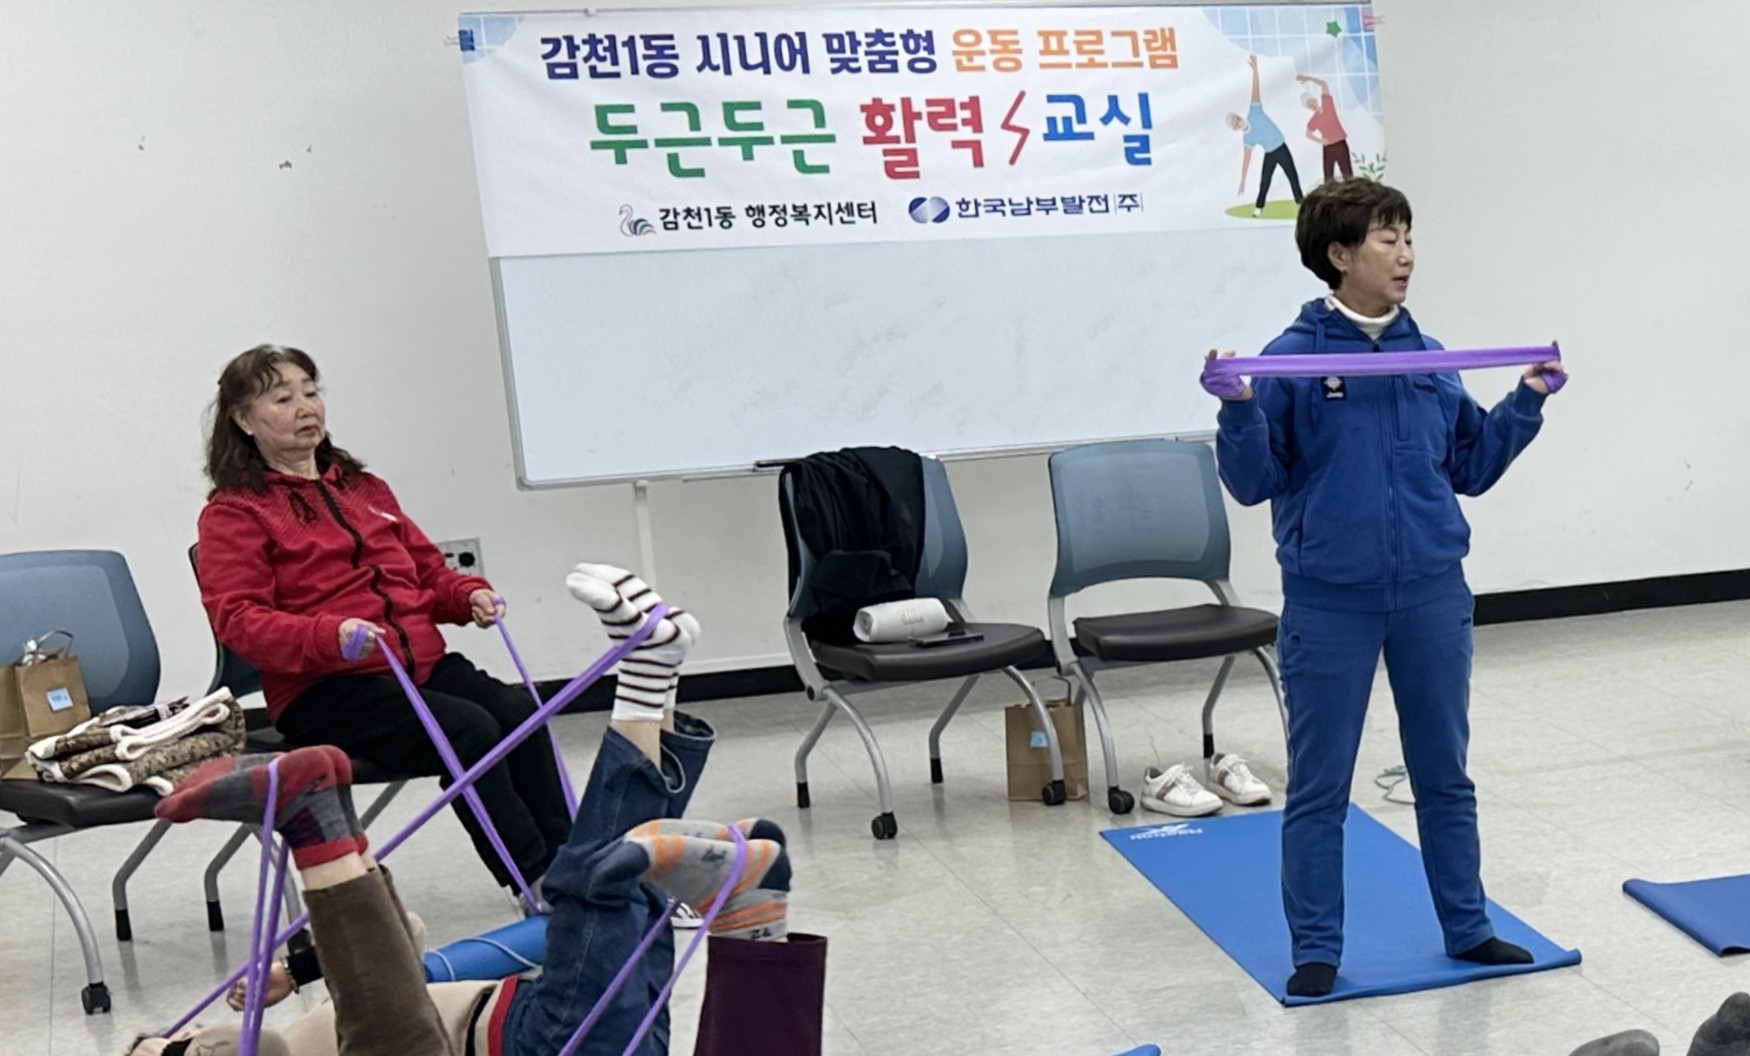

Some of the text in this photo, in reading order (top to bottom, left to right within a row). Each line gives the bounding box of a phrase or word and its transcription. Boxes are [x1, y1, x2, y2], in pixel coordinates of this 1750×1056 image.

[540, 27, 1179, 80] 감천1동 시니어 맞춤형 운동 프로그램
[589, 91, 1153, 180] 두근두근 활력 교실
[658, 200, 879, 231] 감천1동 행정복지센터
